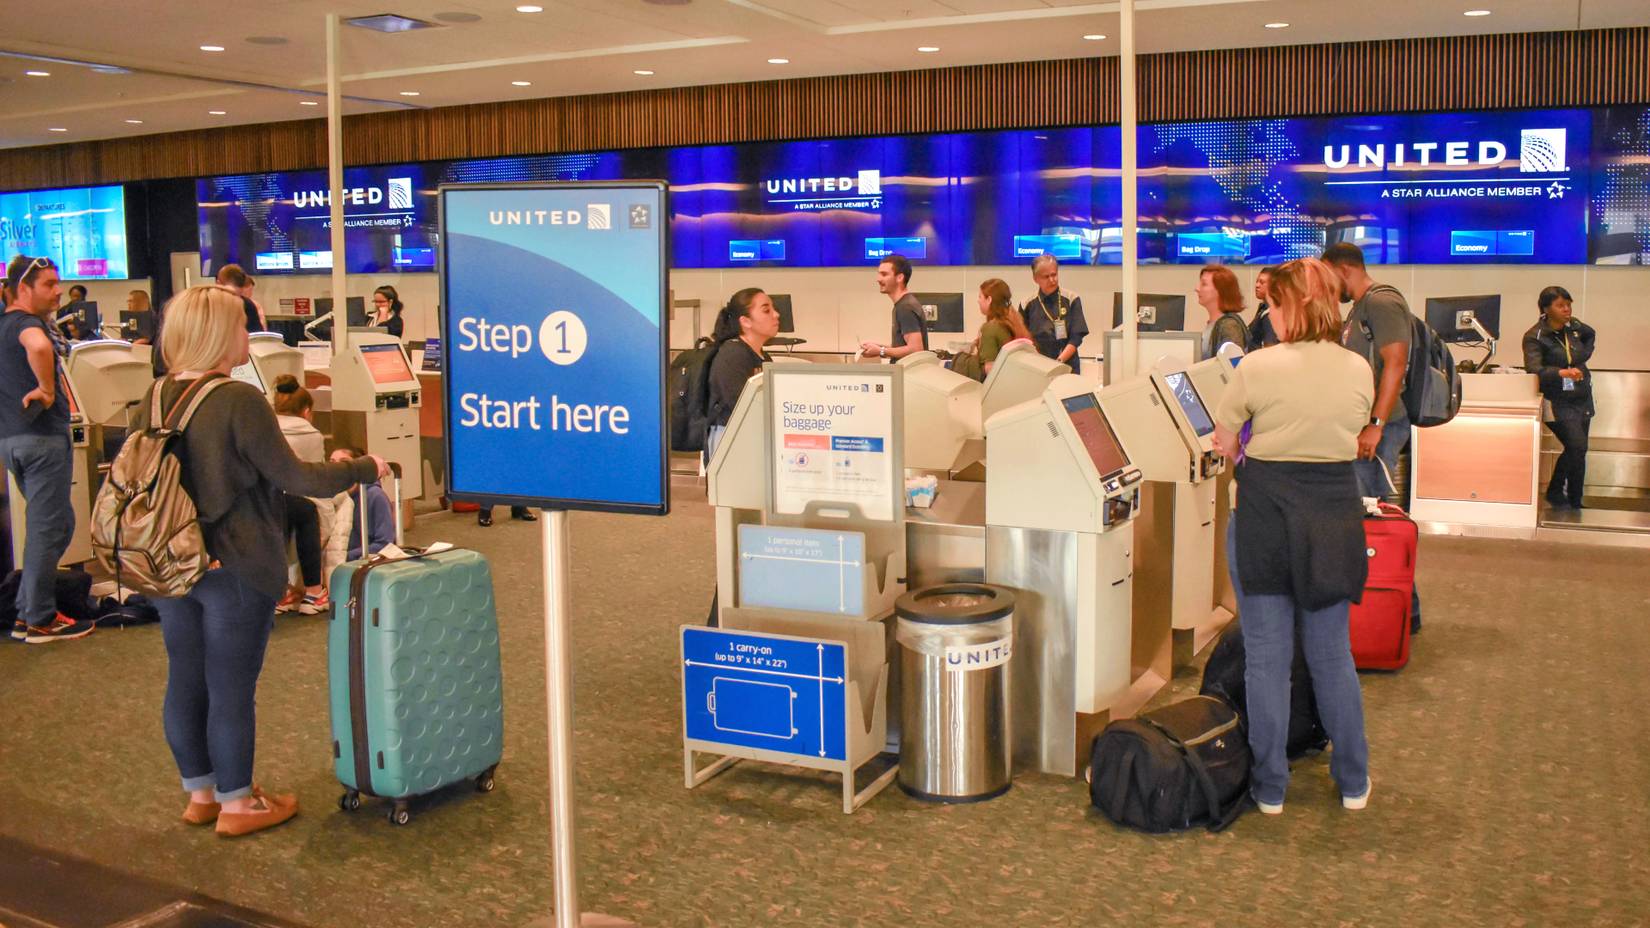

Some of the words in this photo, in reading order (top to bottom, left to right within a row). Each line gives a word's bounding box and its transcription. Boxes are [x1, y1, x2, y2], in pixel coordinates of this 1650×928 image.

[1324, 141, 1506, 168] UNITED
[767, 177, 852, 193] UNITED
[1381, 189, 1390, 198] A
[1392, 188, 1422, 198] STAR
[1425, 187, 1484, 197] ALLIANCE
[1487, 186, 1542, 197] MEMBER
[489, 211, 582, 225] UNITED
[1018, 247, 1045, 255] Economy
[1454, 244, 1489, 253] Economy
[459, 317, 532, 358] Step
[555, 321, 571, 353] 1
[460, 393, 540, 431] Start
[552, 394, 630, 434] here
[783, 401, 807, 414] Size
[809, 404, 824, 416] up
[828, 405, 855, 417] your
[783, 416, 831, 431] baggage
[736, 644, 772, 655] carry-on
[715, 652, 726, 662] (up
[727, 654, 735, 662] to
